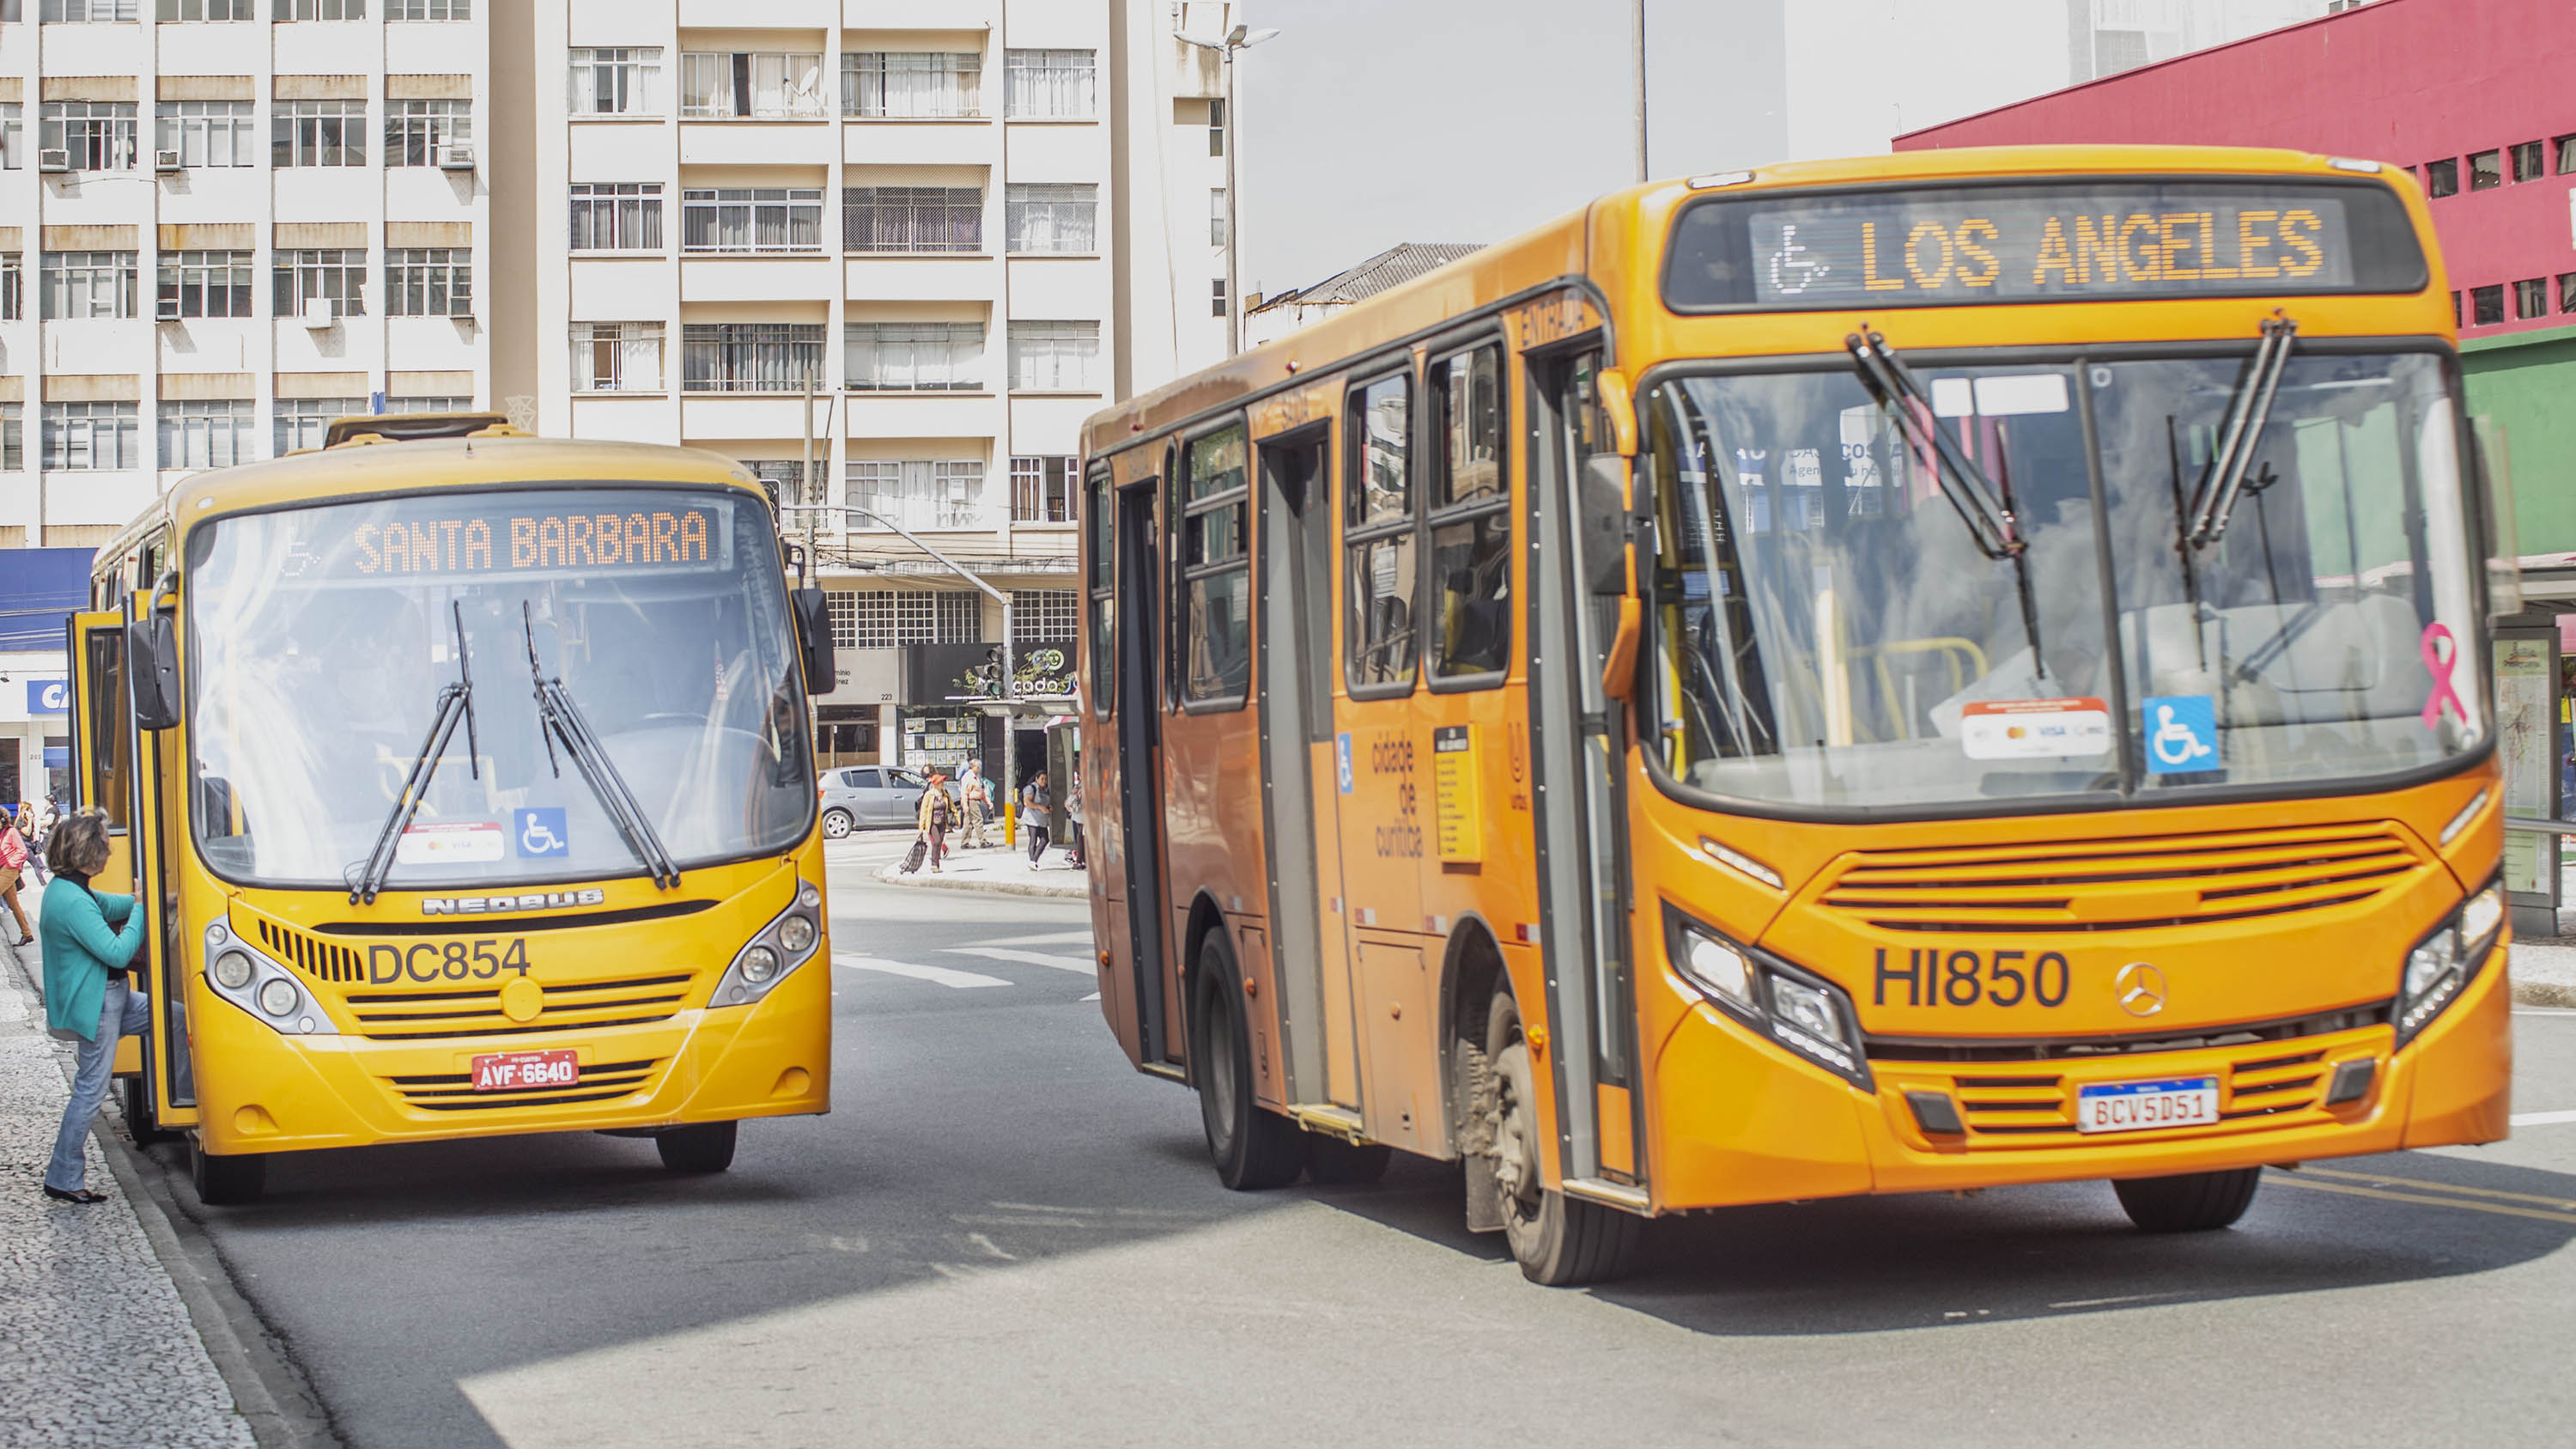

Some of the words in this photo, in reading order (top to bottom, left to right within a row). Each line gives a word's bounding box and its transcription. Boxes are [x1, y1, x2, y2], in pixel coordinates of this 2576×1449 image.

[1862, 218, 2000, 292] LOS
[2032, 209, 2324, 285] ANGELES
[353, 518, 492, 574] SANTA
[510, 511, 708, 569] BARBARA
[1373, 732, 1413, 774] cidade
[1400, 775, 1417, 815] de
[422, 888, 604, 916] NEOBUS
[368, 938, 531, 984] DC854
[1873, 947, 2069, 1008] HI850
[2096, 1094, 2204, 1126] BCV5D51
